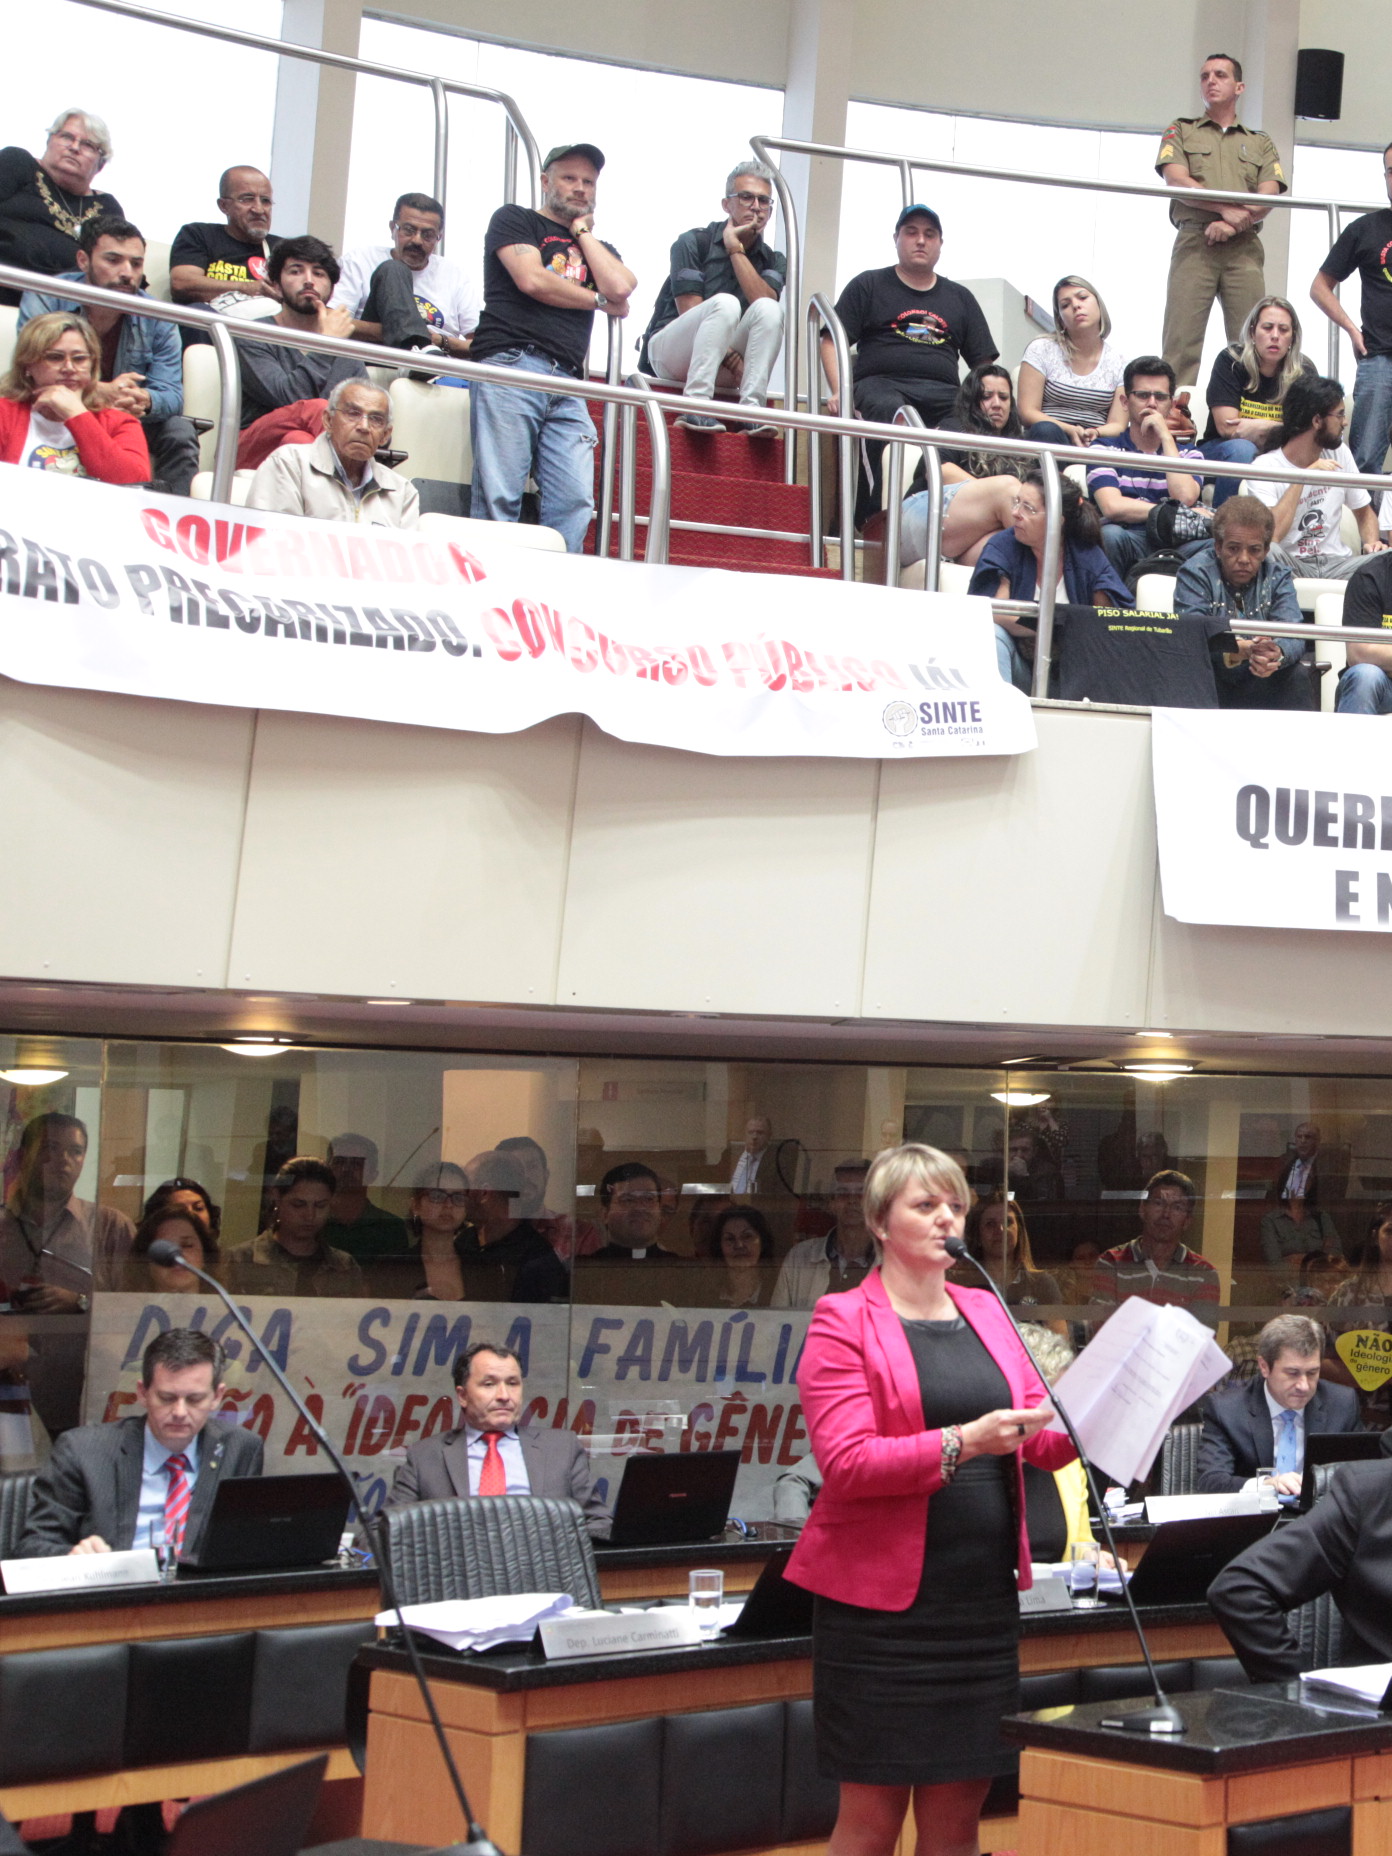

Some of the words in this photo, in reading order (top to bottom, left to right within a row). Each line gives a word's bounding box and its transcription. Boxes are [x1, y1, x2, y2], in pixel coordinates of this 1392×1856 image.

[140, 507, 488, 586] GOVERNADOR
[124, 563, 482, 658] PRECARIZADO.
[1098, 609, 1120, 617] PISO
[1122, 610, 1165, 619] SALARIAL
[919, 701, 982, 725] SINTE
[921, 727, 945, 736] Santa
[948, 725, 983, 735] Catarina
[1335, 869, 1360, 925] E
[347, 1306, 472, 1377] SIM
[577, 1310, 805, 1385] FAMÍLI
[1355, 1332, 1392, 1353] NÃO
[1356, 1362, 1391, 1375] gênero
[679, 1390, 806, 1466] GÊNE
[567, 1637, 588, 1651] Dep.
[592, 1634, 628, 1648] Luciane
[631, 1628, 679, 1642] Carminatti
